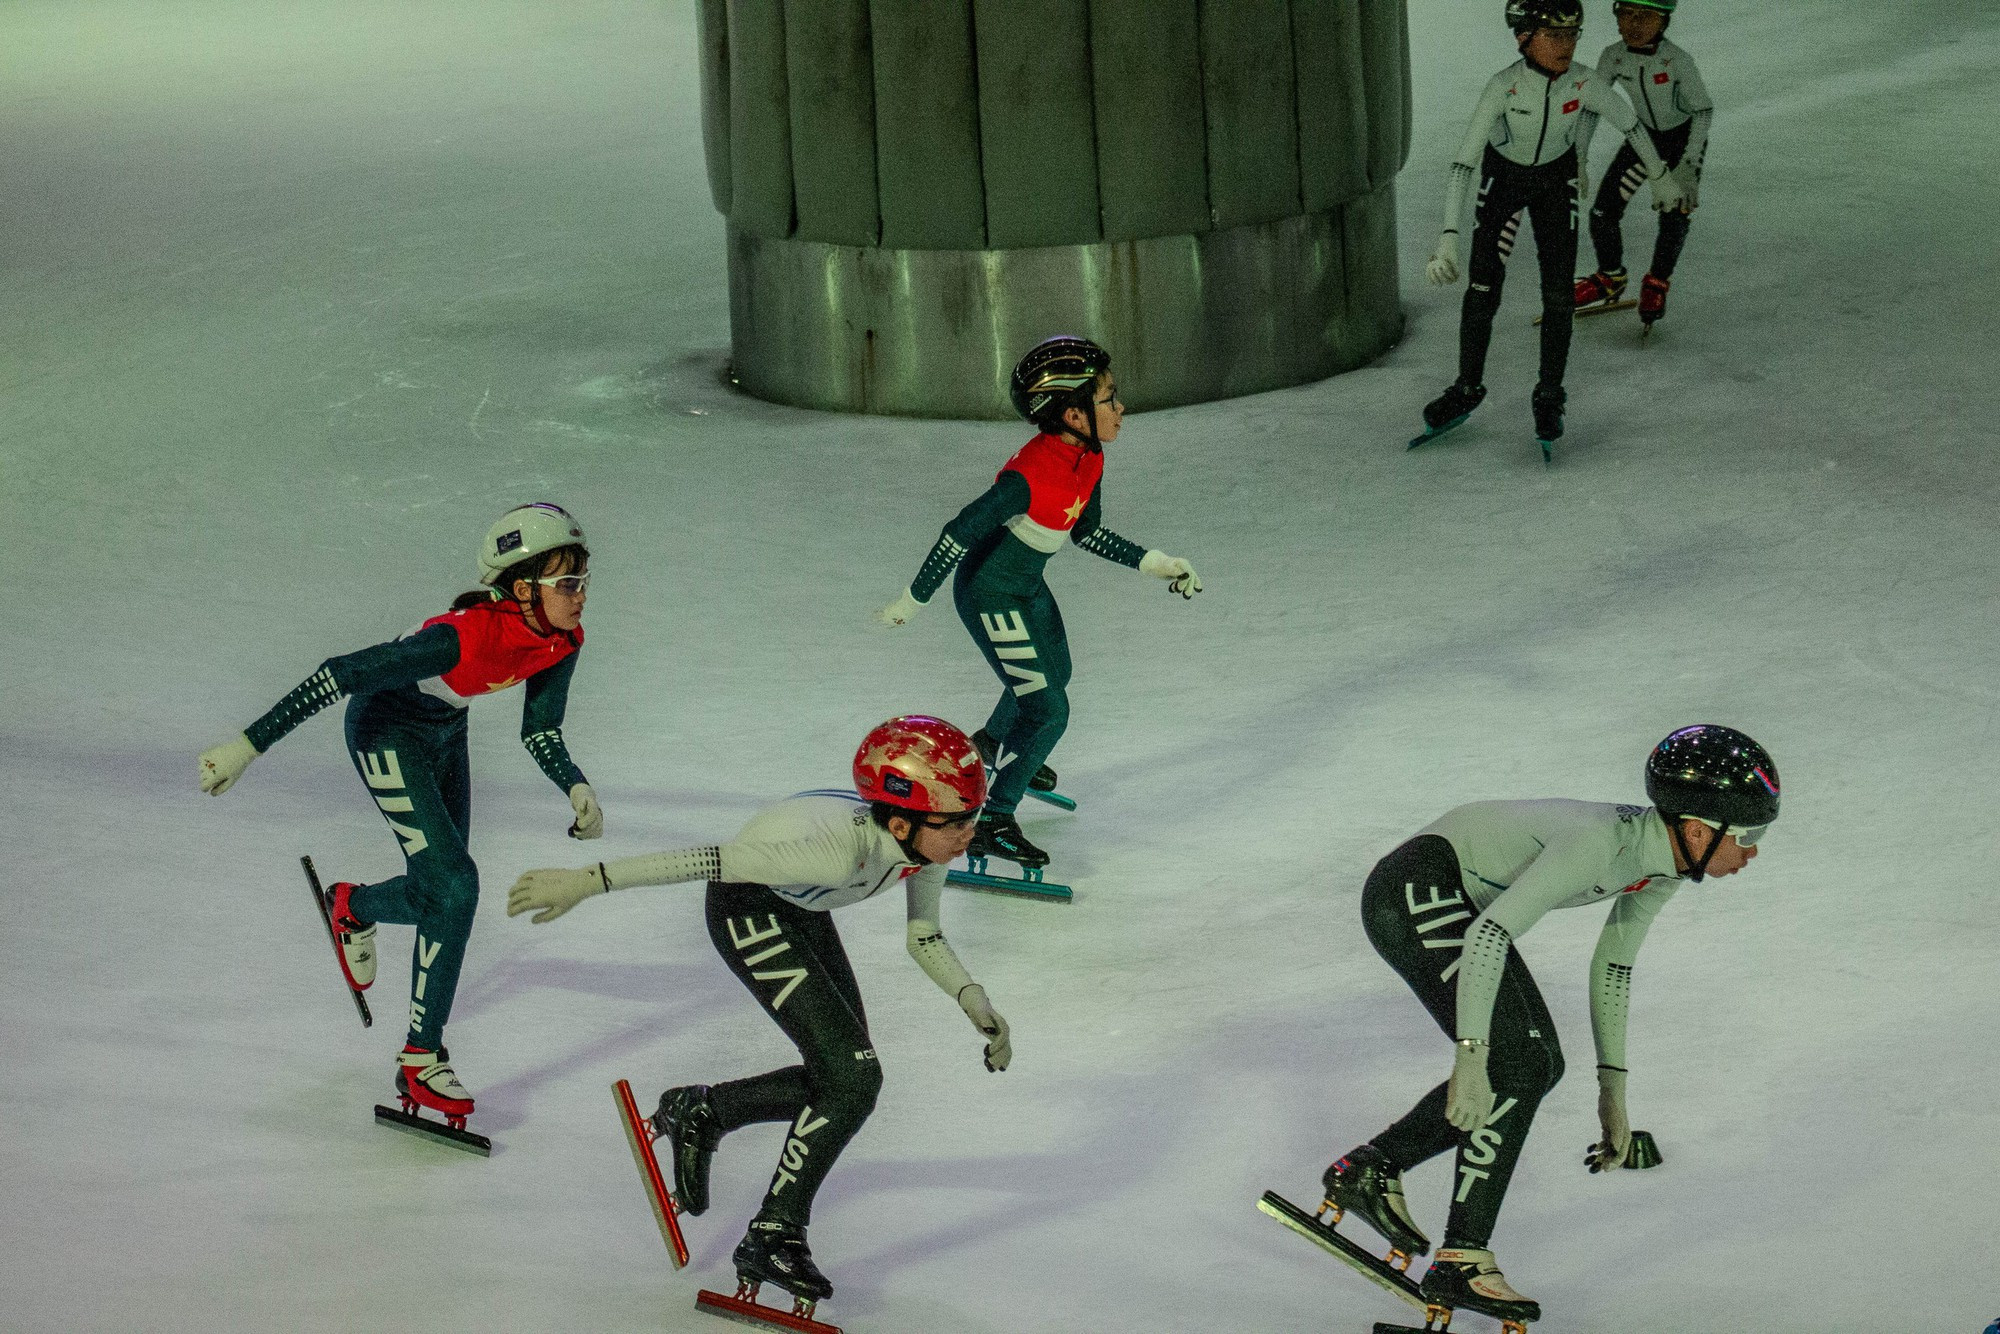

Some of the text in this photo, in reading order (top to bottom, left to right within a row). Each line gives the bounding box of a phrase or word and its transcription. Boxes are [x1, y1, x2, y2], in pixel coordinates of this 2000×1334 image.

[980, 611, 1048, 697] VIE
[356, 750, 429, 857] VIE
[726, 913, 809, 1011] VIE
[1405, 883, 1473, 983] VIE
[409, 934, 443, 1033] VIE
[771, 1105, 830, 1196] VST
